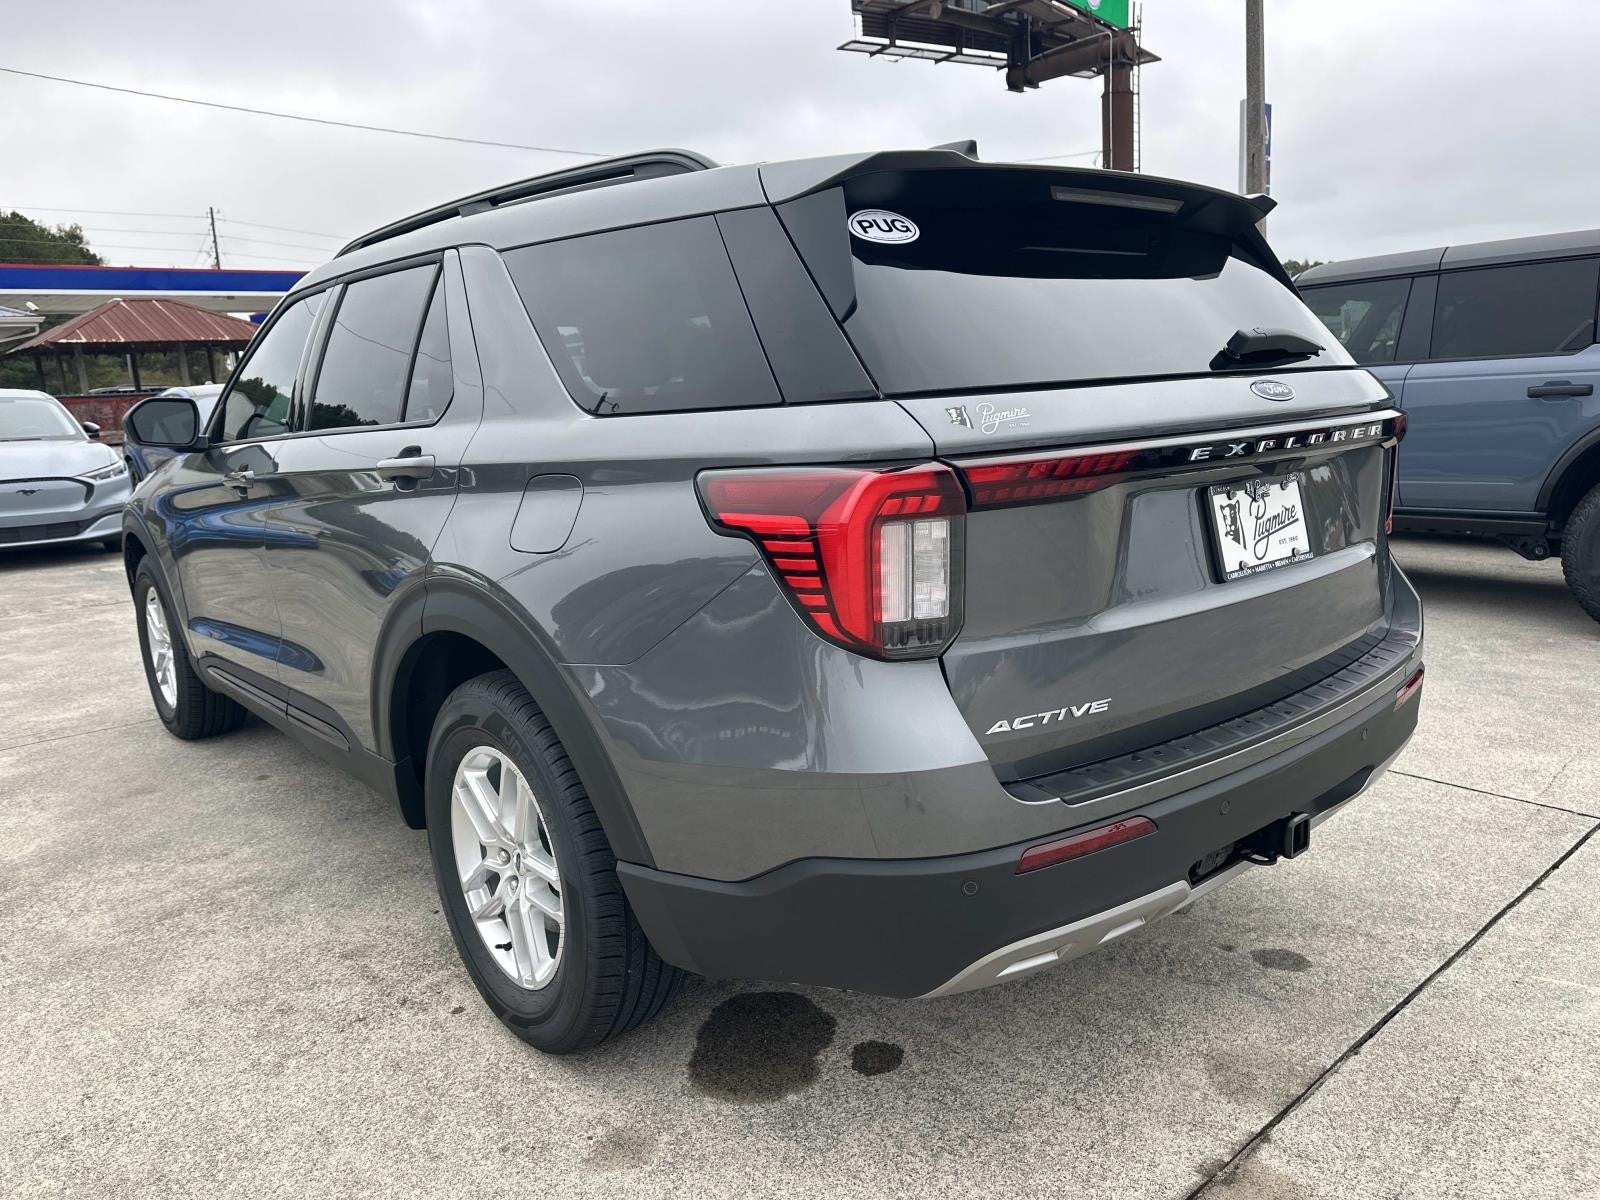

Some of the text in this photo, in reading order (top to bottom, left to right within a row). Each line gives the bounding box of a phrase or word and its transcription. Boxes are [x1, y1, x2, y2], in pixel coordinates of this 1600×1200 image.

[856, 218, 913, 234] PUG
[976, 402, 1031, 434] Pugmire
[1189, 424, 1382, 461] EXPLORER
[1249, 499, 1299, 560] Pugmire
[984, 697, 1112, 735] ACTIVE
